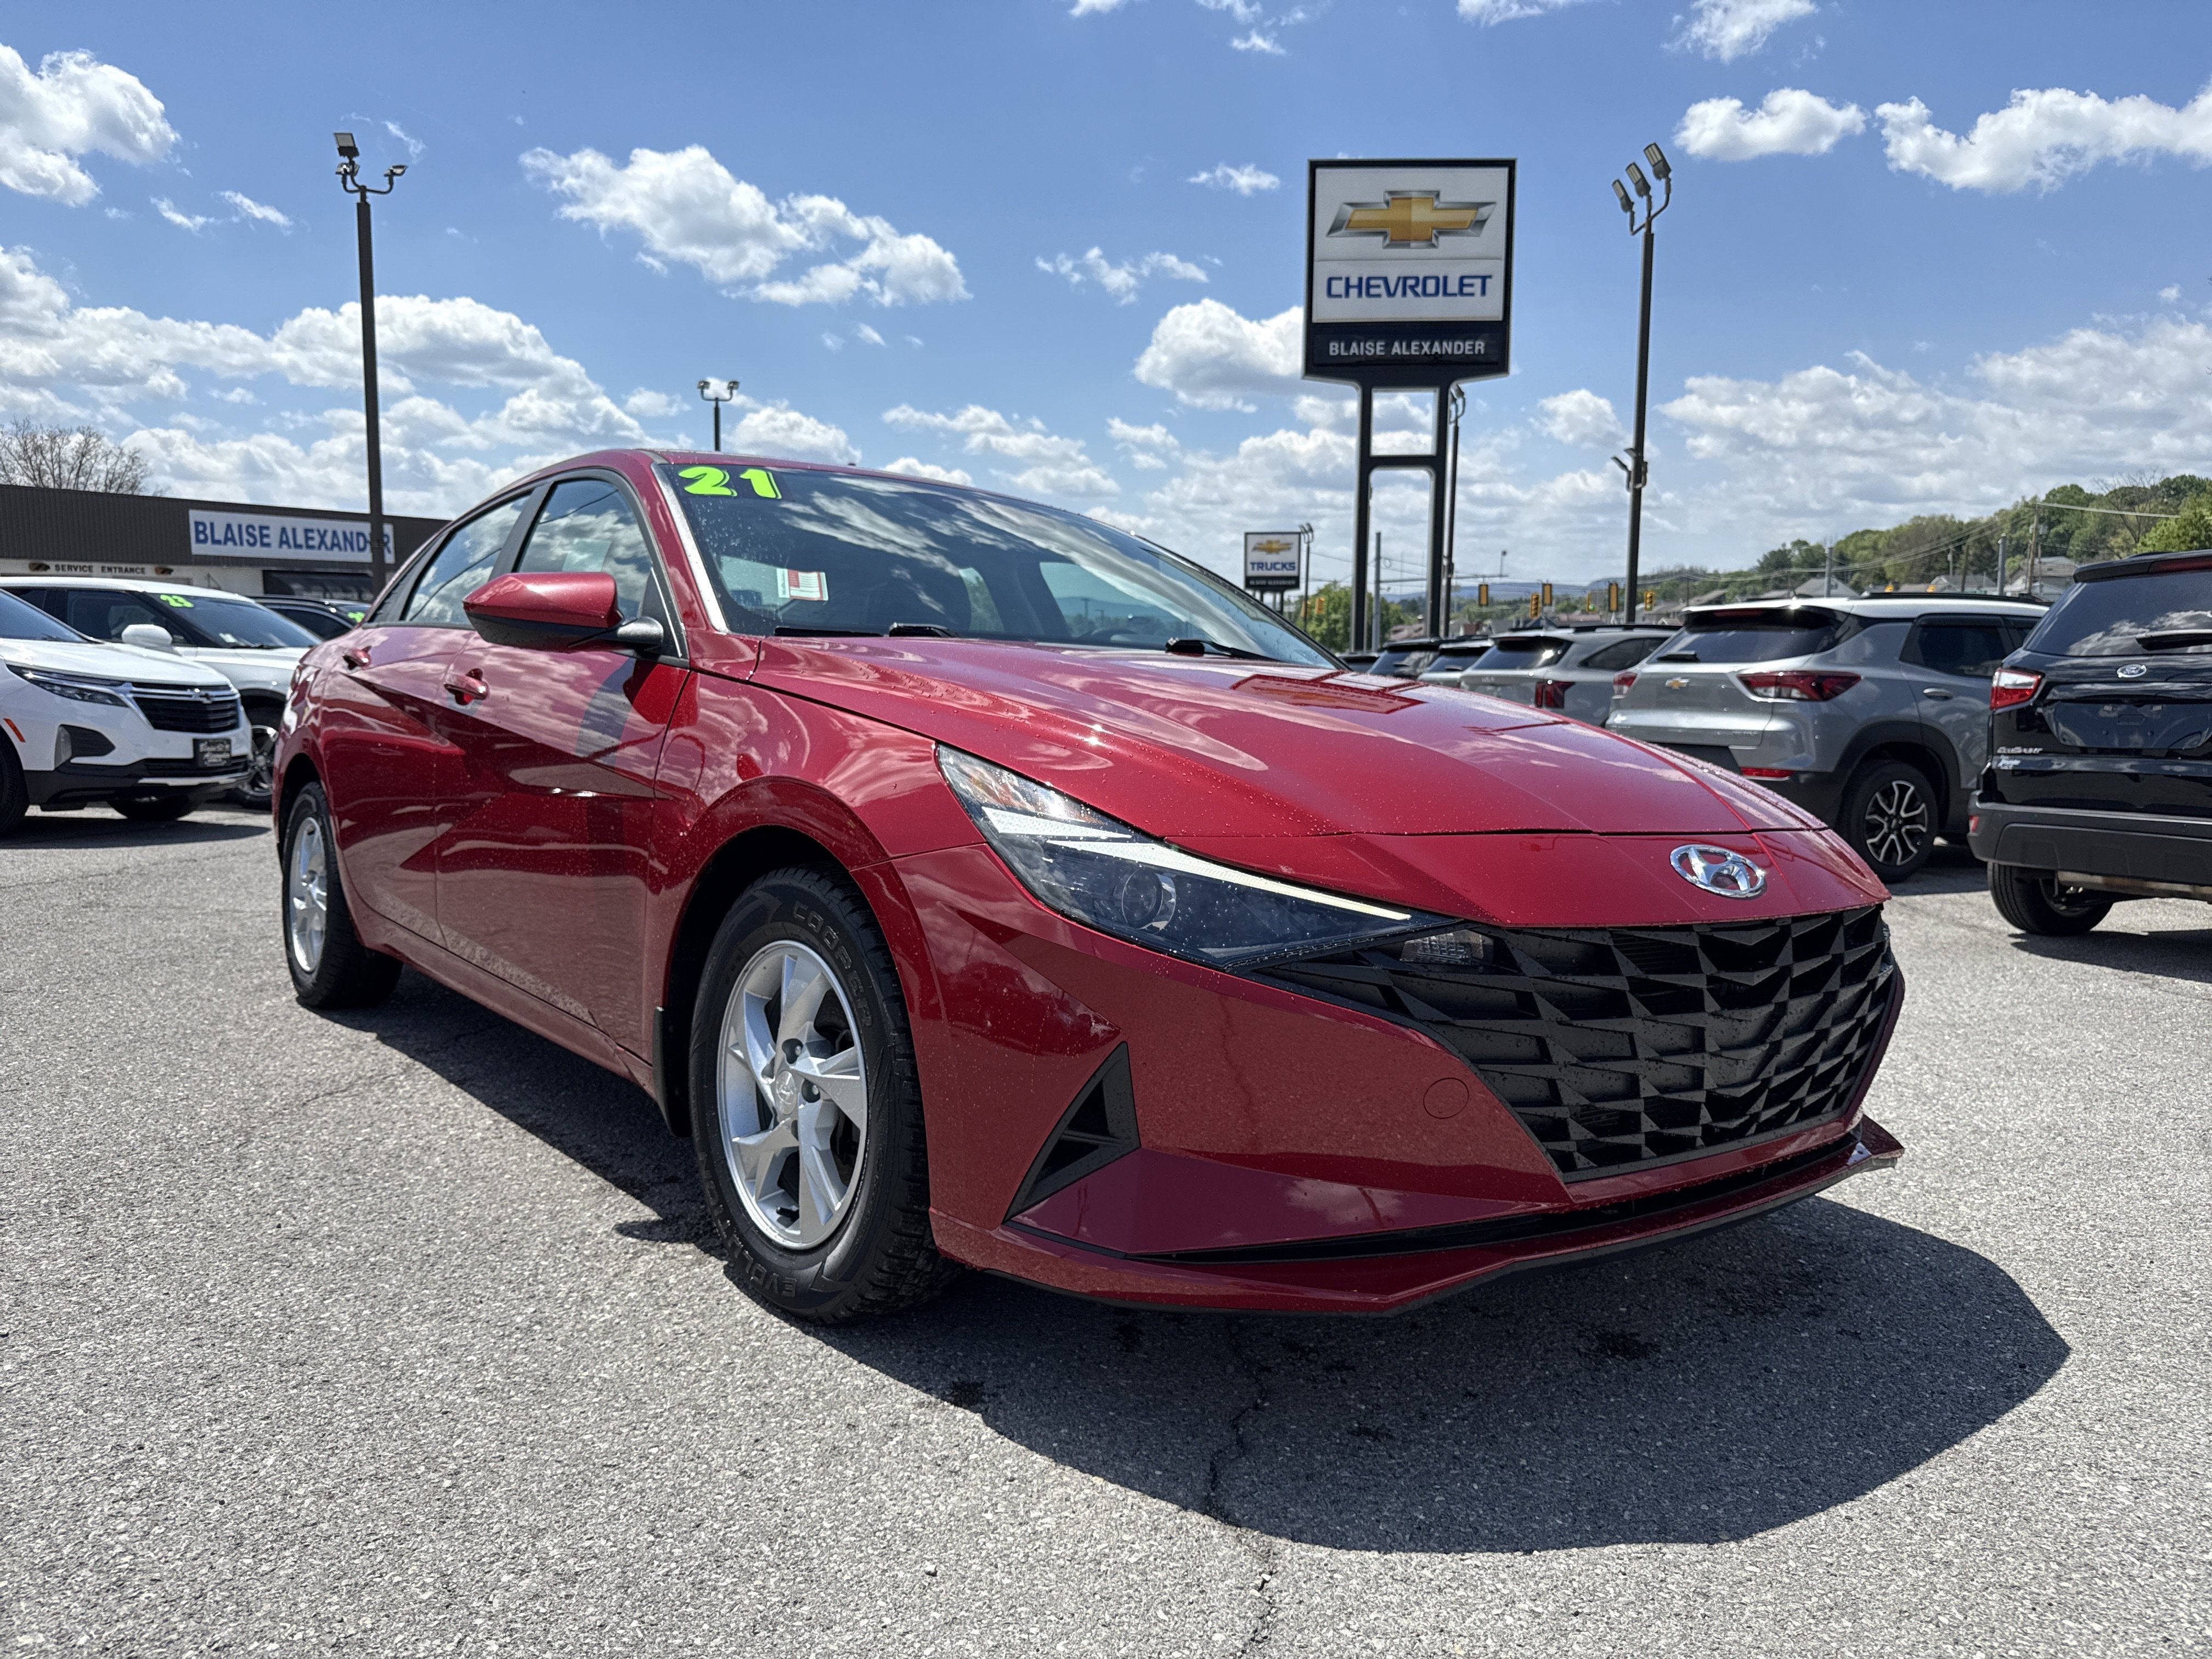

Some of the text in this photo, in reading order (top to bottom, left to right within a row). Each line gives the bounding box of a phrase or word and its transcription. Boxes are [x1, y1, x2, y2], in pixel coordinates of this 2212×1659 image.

[1327, 275, 1492, 298] CHEVROLET
[1329, 340, 1486, 356] BLAISE ALEXANDER
[678, 466, 782, 499] 21
[194, 521, 392, 554] BLAISE ALEXANDR
[55, 563, 145, 574] SERVICE ENTRANCE
[1250, 562, 1296, 571] TRUCKS
[793, 901, 872, 1026] COOPER
